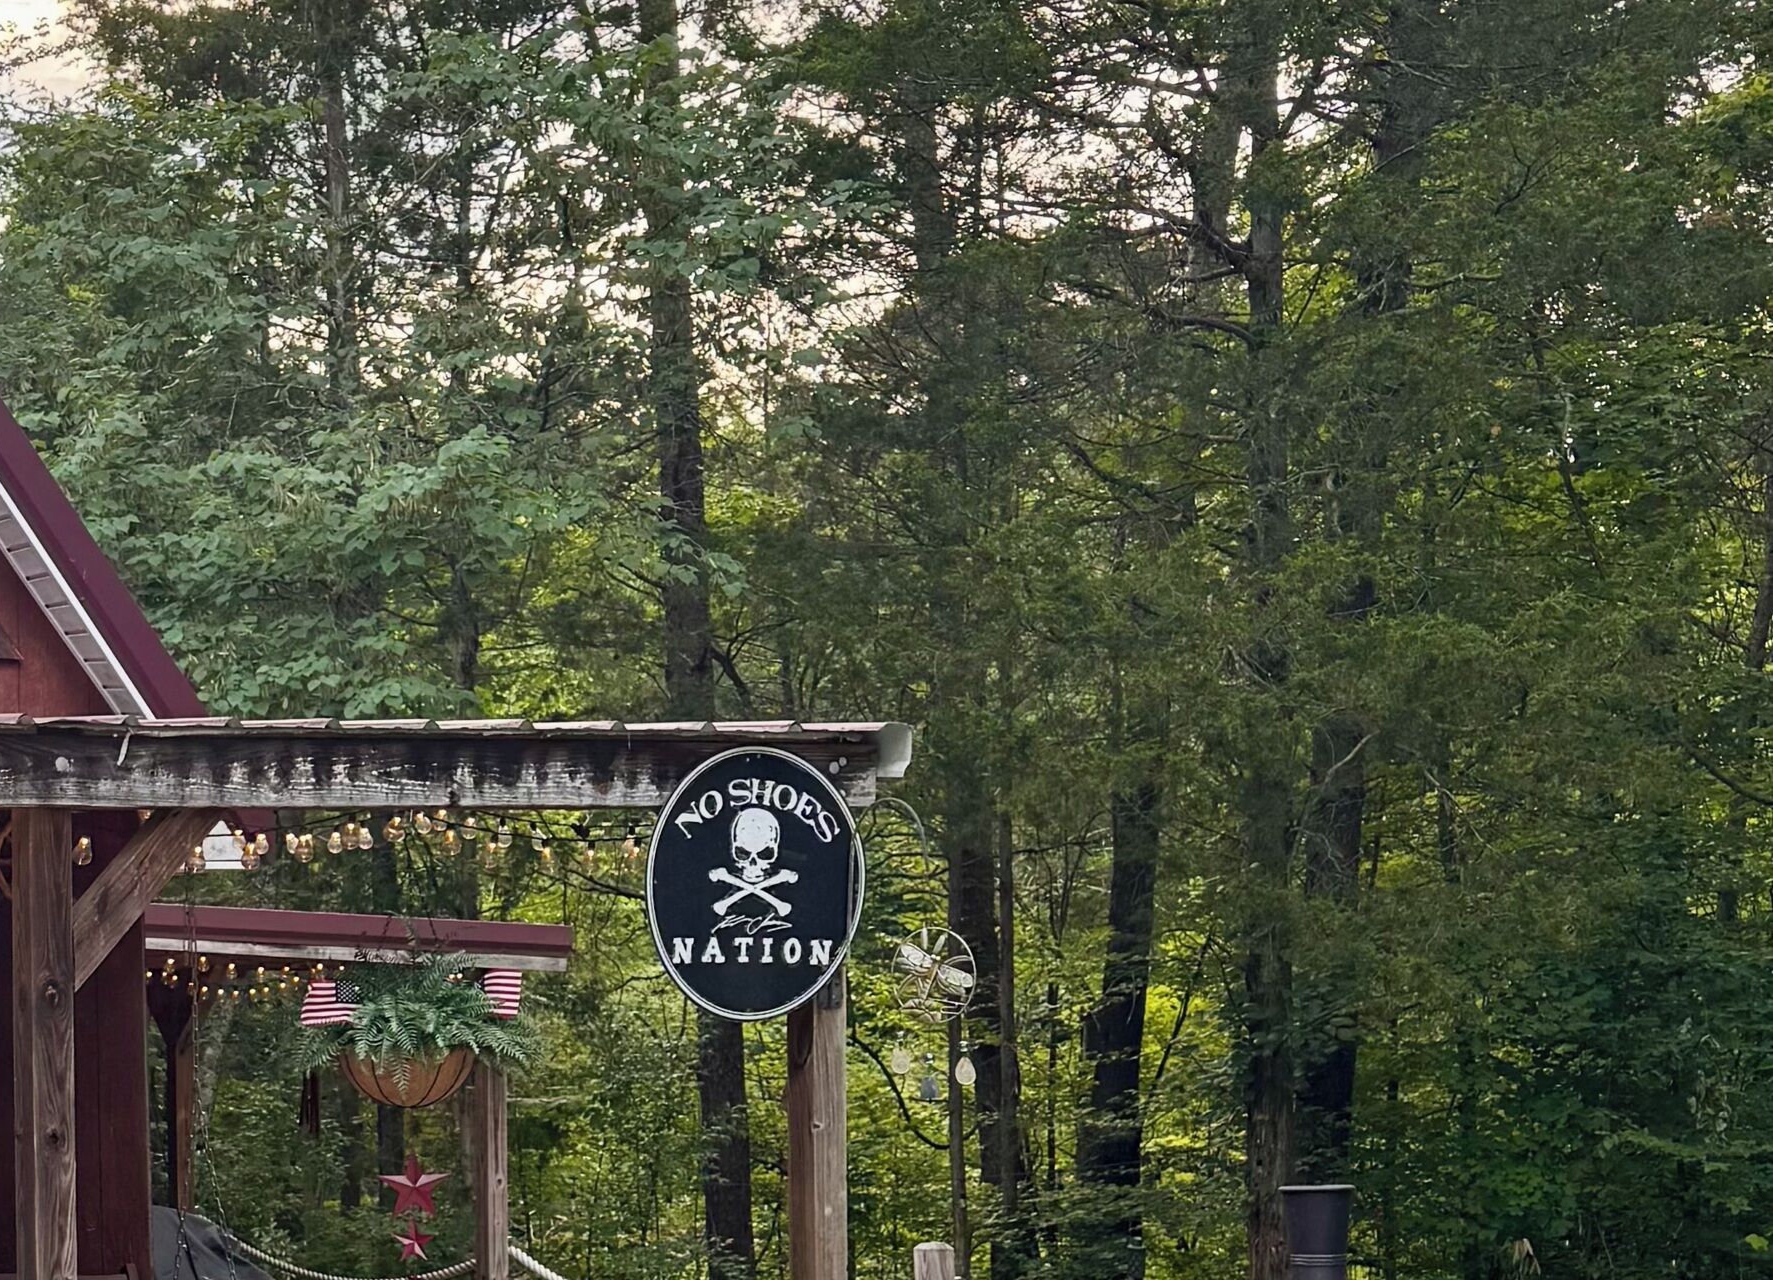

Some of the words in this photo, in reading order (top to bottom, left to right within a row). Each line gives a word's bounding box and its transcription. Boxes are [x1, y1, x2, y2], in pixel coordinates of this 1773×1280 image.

[675, 790, 724, 839] NO
[728, 777, 841, 843] SHOES
[672, 937, 834, 966] NATION
